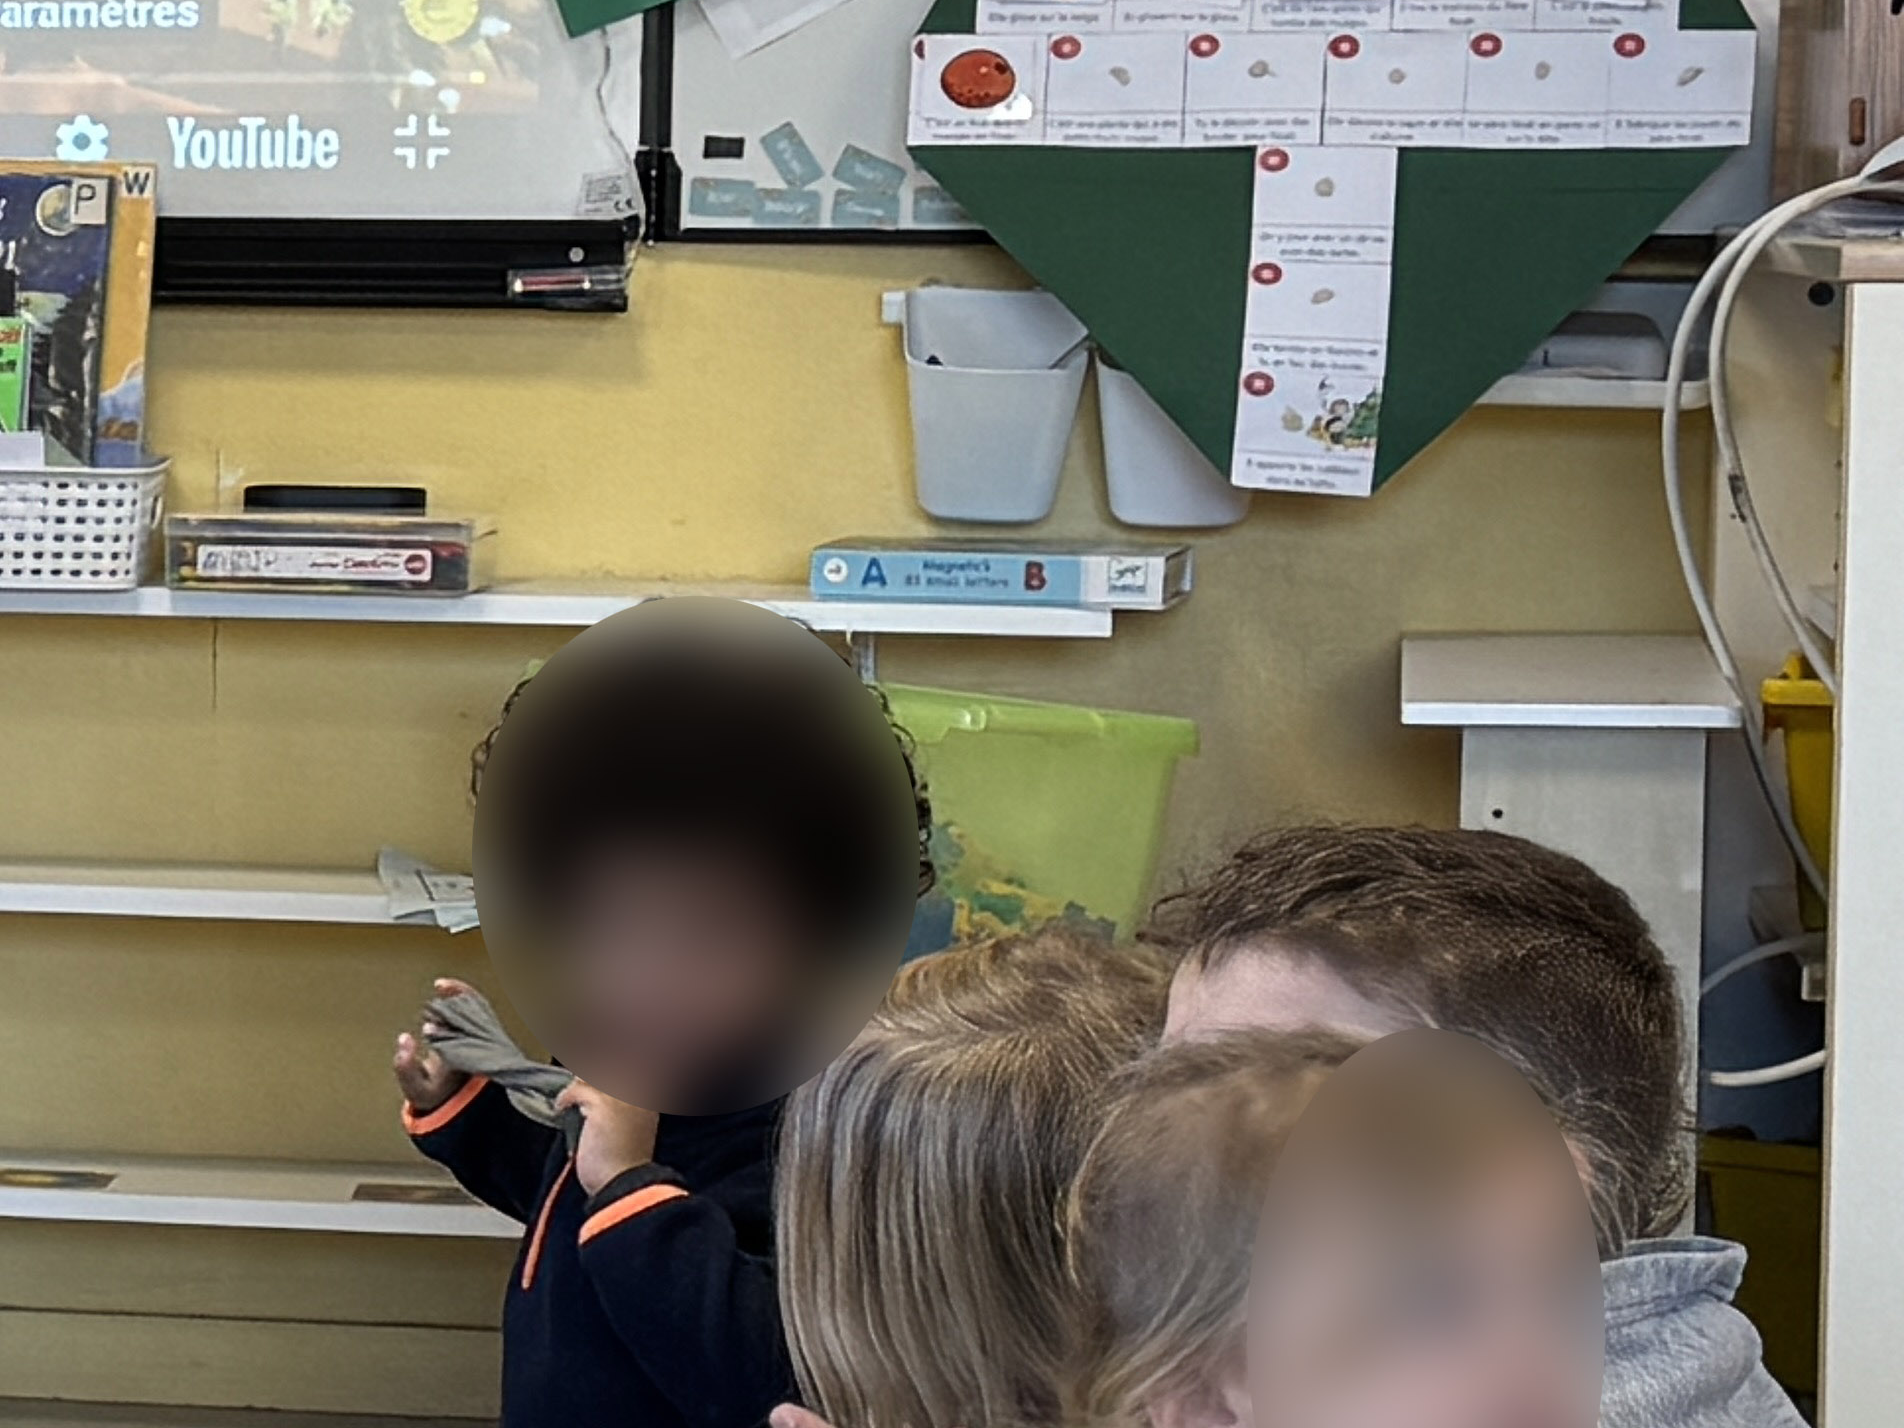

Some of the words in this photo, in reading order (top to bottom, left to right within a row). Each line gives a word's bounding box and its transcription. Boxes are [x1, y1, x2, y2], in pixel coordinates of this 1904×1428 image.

[167, 115, 340, 172] YouTube
[75, 183, 96, 216] P
[124, 171, 151, 196] W
[861, 557, 888, 588] A
[1023, 560, 1047, 592] B
